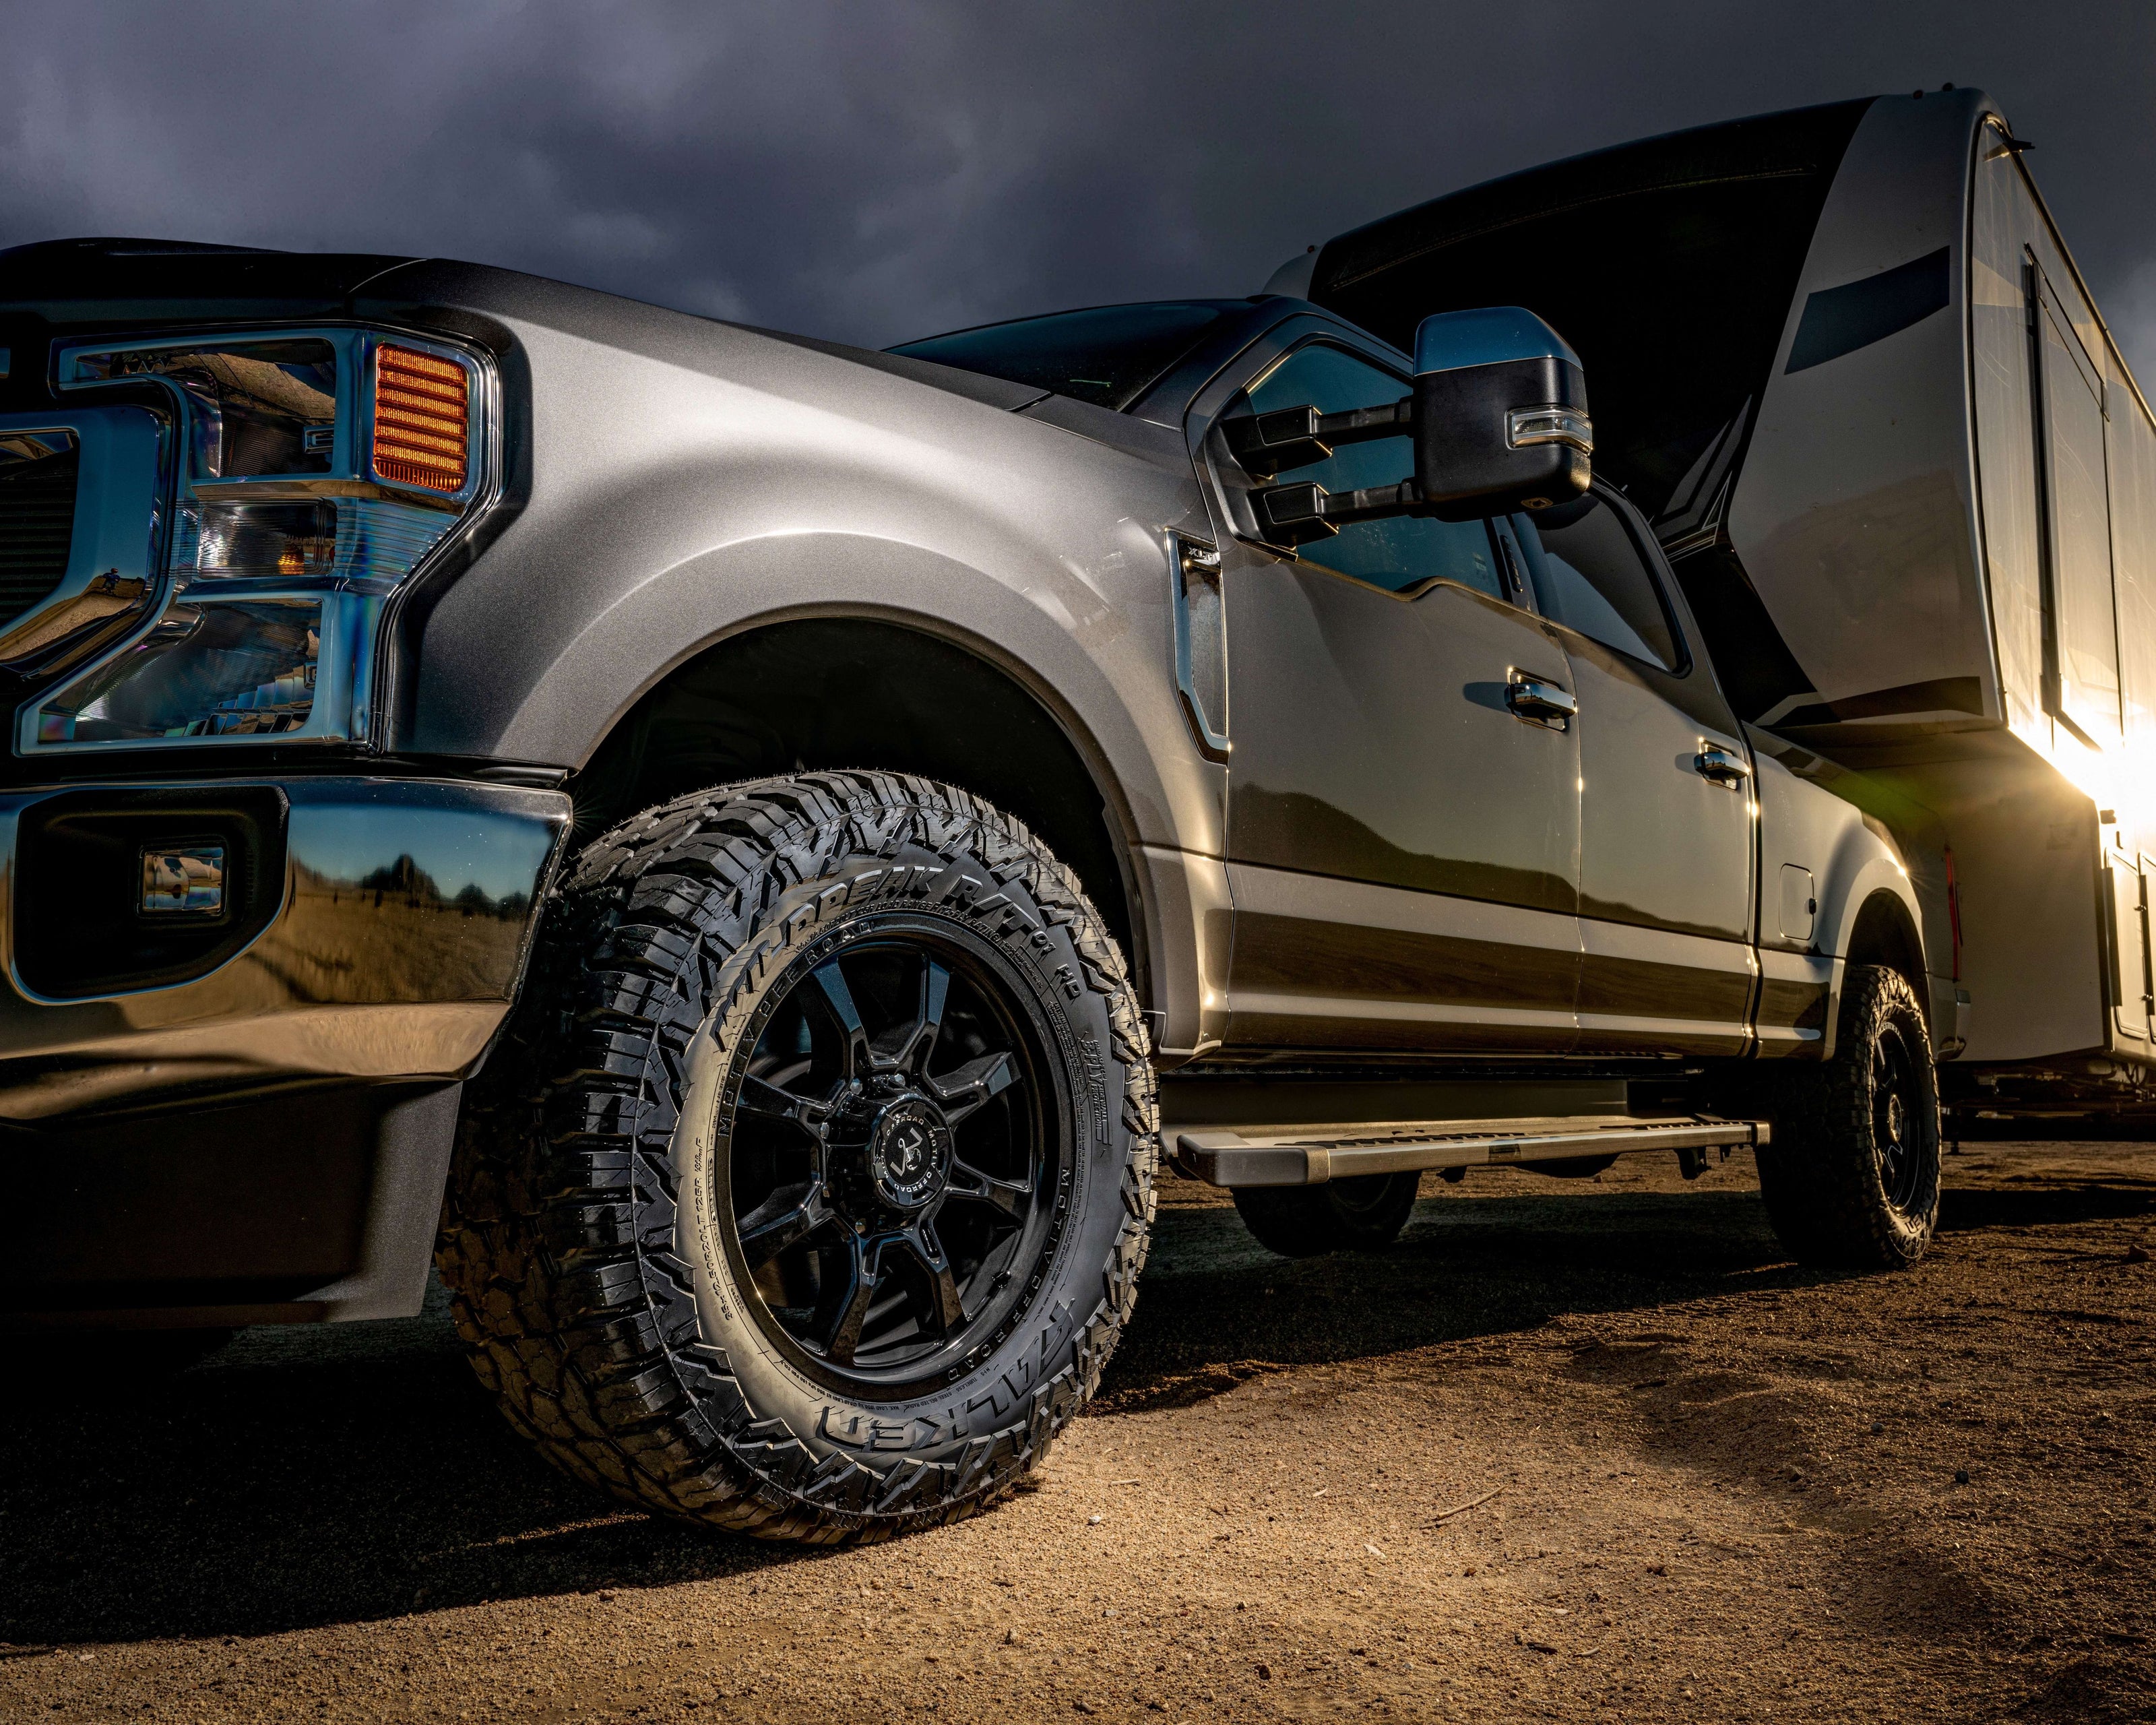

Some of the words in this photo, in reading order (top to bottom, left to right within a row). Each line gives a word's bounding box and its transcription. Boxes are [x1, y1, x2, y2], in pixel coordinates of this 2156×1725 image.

[899, 899, 932, 911] RANGE
[1056, 964, 1083, 998] HD
[1081, 1040, 1104, 1082] 3-PLY
[718, 1026, 755, 1137] MOTIV
[1091, 1084, 1102, 1129] PROTECTION
[1098, 1084, 1107, 1121] SIDEWALL
[886, 1115, 924, 1137] OFFROAD
[928, 1129, 938, 1168] MOTIV
[694, 1177, 703, 1214] 125R
[893, 1171, 932, 1193] OFFROAD
[1044, 1168, 1070, 1263] MOTIV
[780, 1359, 790, 1371] COLD
[817, 1297, 1075, 1453] FALKEN
[920, 1397, 937, 1406] BELTED
[938, 1391, 952, 1400] STEEL
[955, 1376, 977, 1393] TUBELESS
